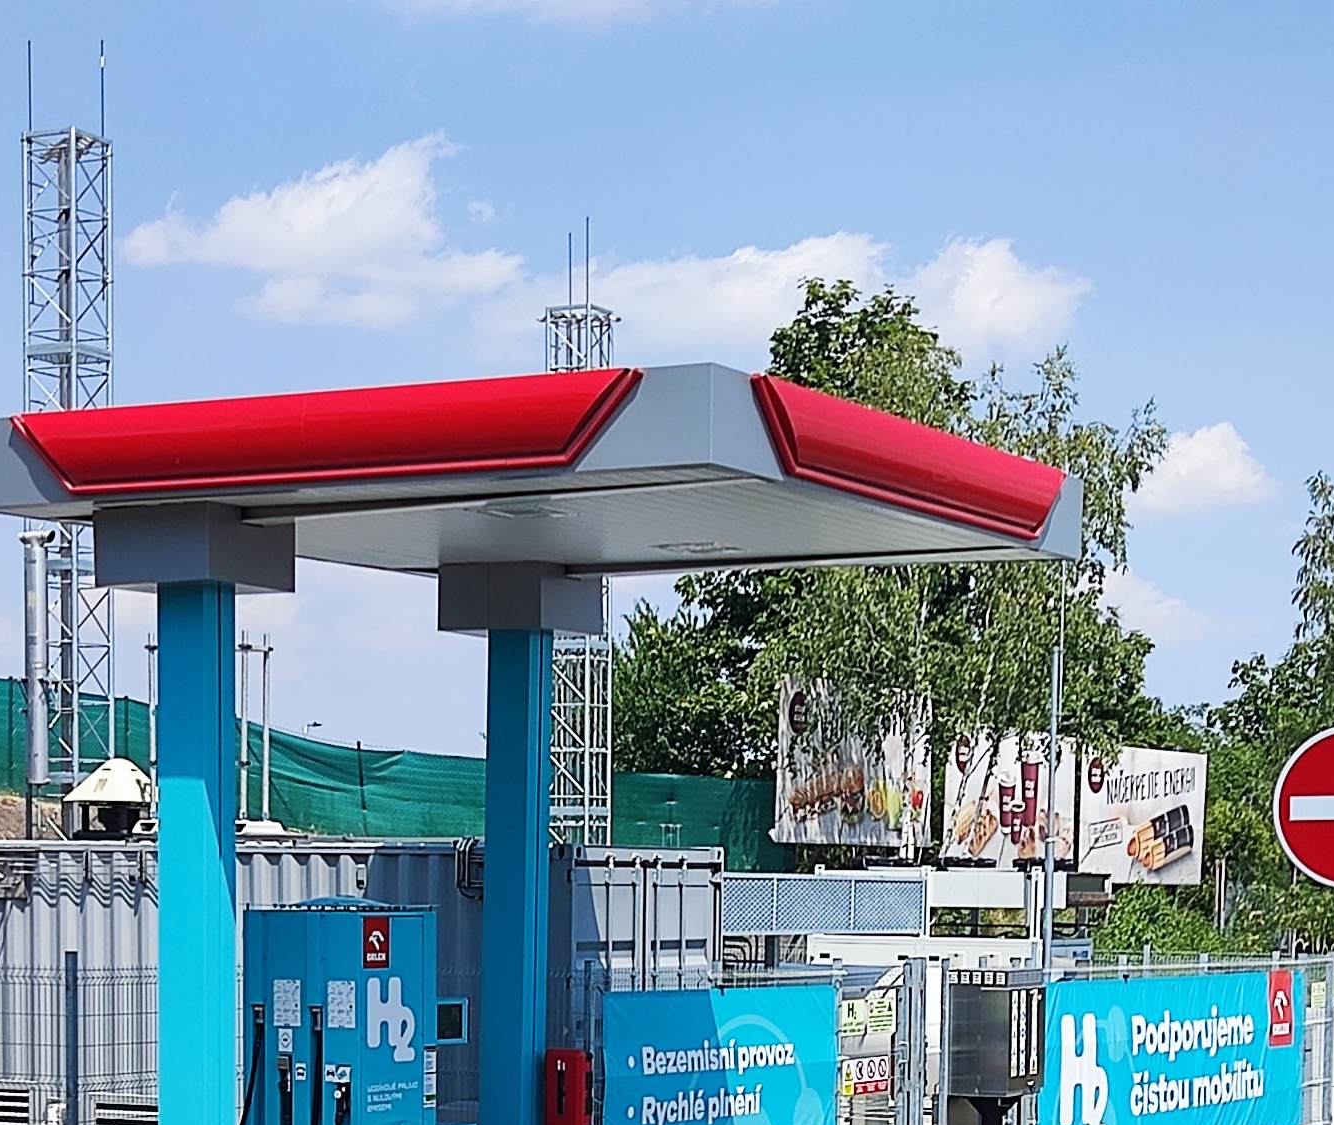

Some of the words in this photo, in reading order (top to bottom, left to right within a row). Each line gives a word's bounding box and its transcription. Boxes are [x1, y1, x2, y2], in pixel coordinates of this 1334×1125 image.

[642, 1039, 736, 1075] Bezemisní
[738, 1043, 795, 1075] provoz
[1131, 1005, 1254, 1062] Podporujeme
[707, 1084, 762, 1125] plnění
[1130, 1070, 1190, 1117] čistou
[1192, 1057, 1264, 1108] mobilitu
